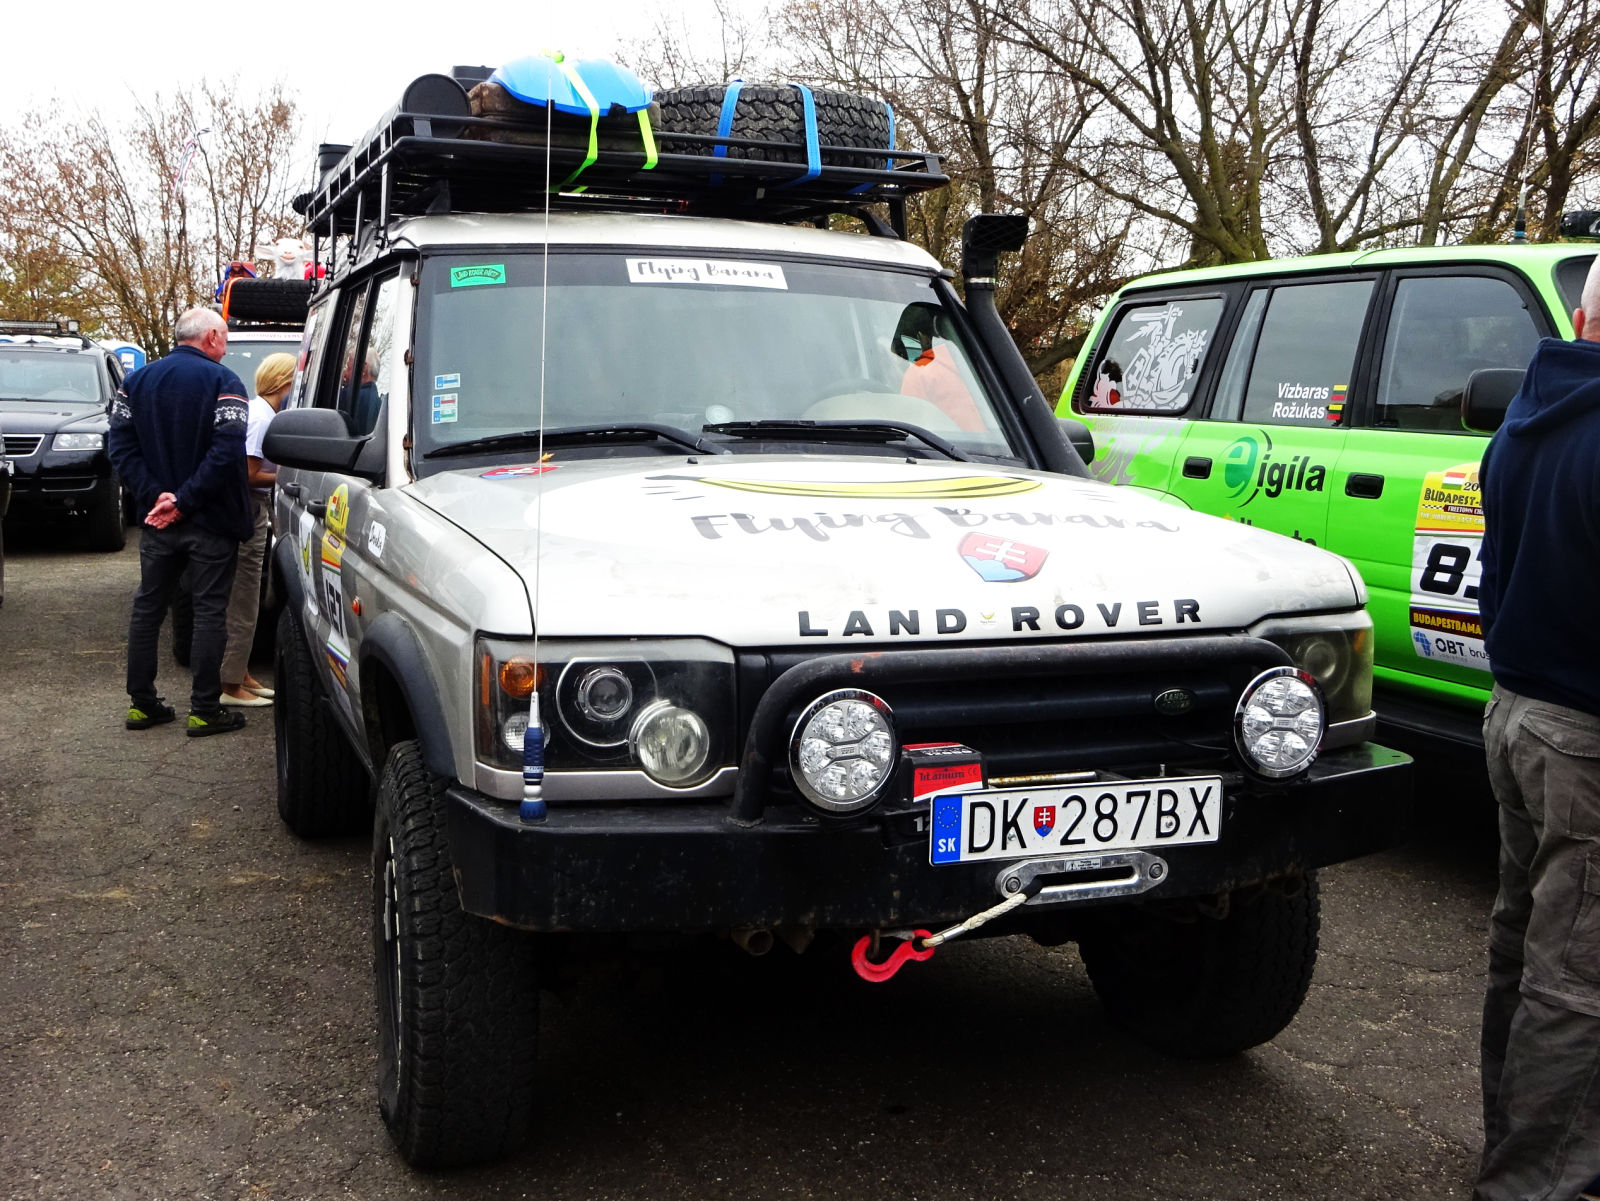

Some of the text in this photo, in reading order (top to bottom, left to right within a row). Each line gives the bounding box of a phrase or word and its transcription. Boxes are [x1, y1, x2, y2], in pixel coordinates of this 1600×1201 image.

[1278, 382, 1329, 400] Vizbaras
[1272, 401, 1325, 419] Rožukas
[1463, 481, 1481, 492] 20
[1423, 487, 1482, 506] BUDAPEST-
[690, 511, 931, 543] Flying
[798, 598, 1201, 637] LAND ROVER
[1435, 637, 1465, 656] OBT
[919, 771, 965, 782] Titanium
[938, 837, 956, 853] SK
